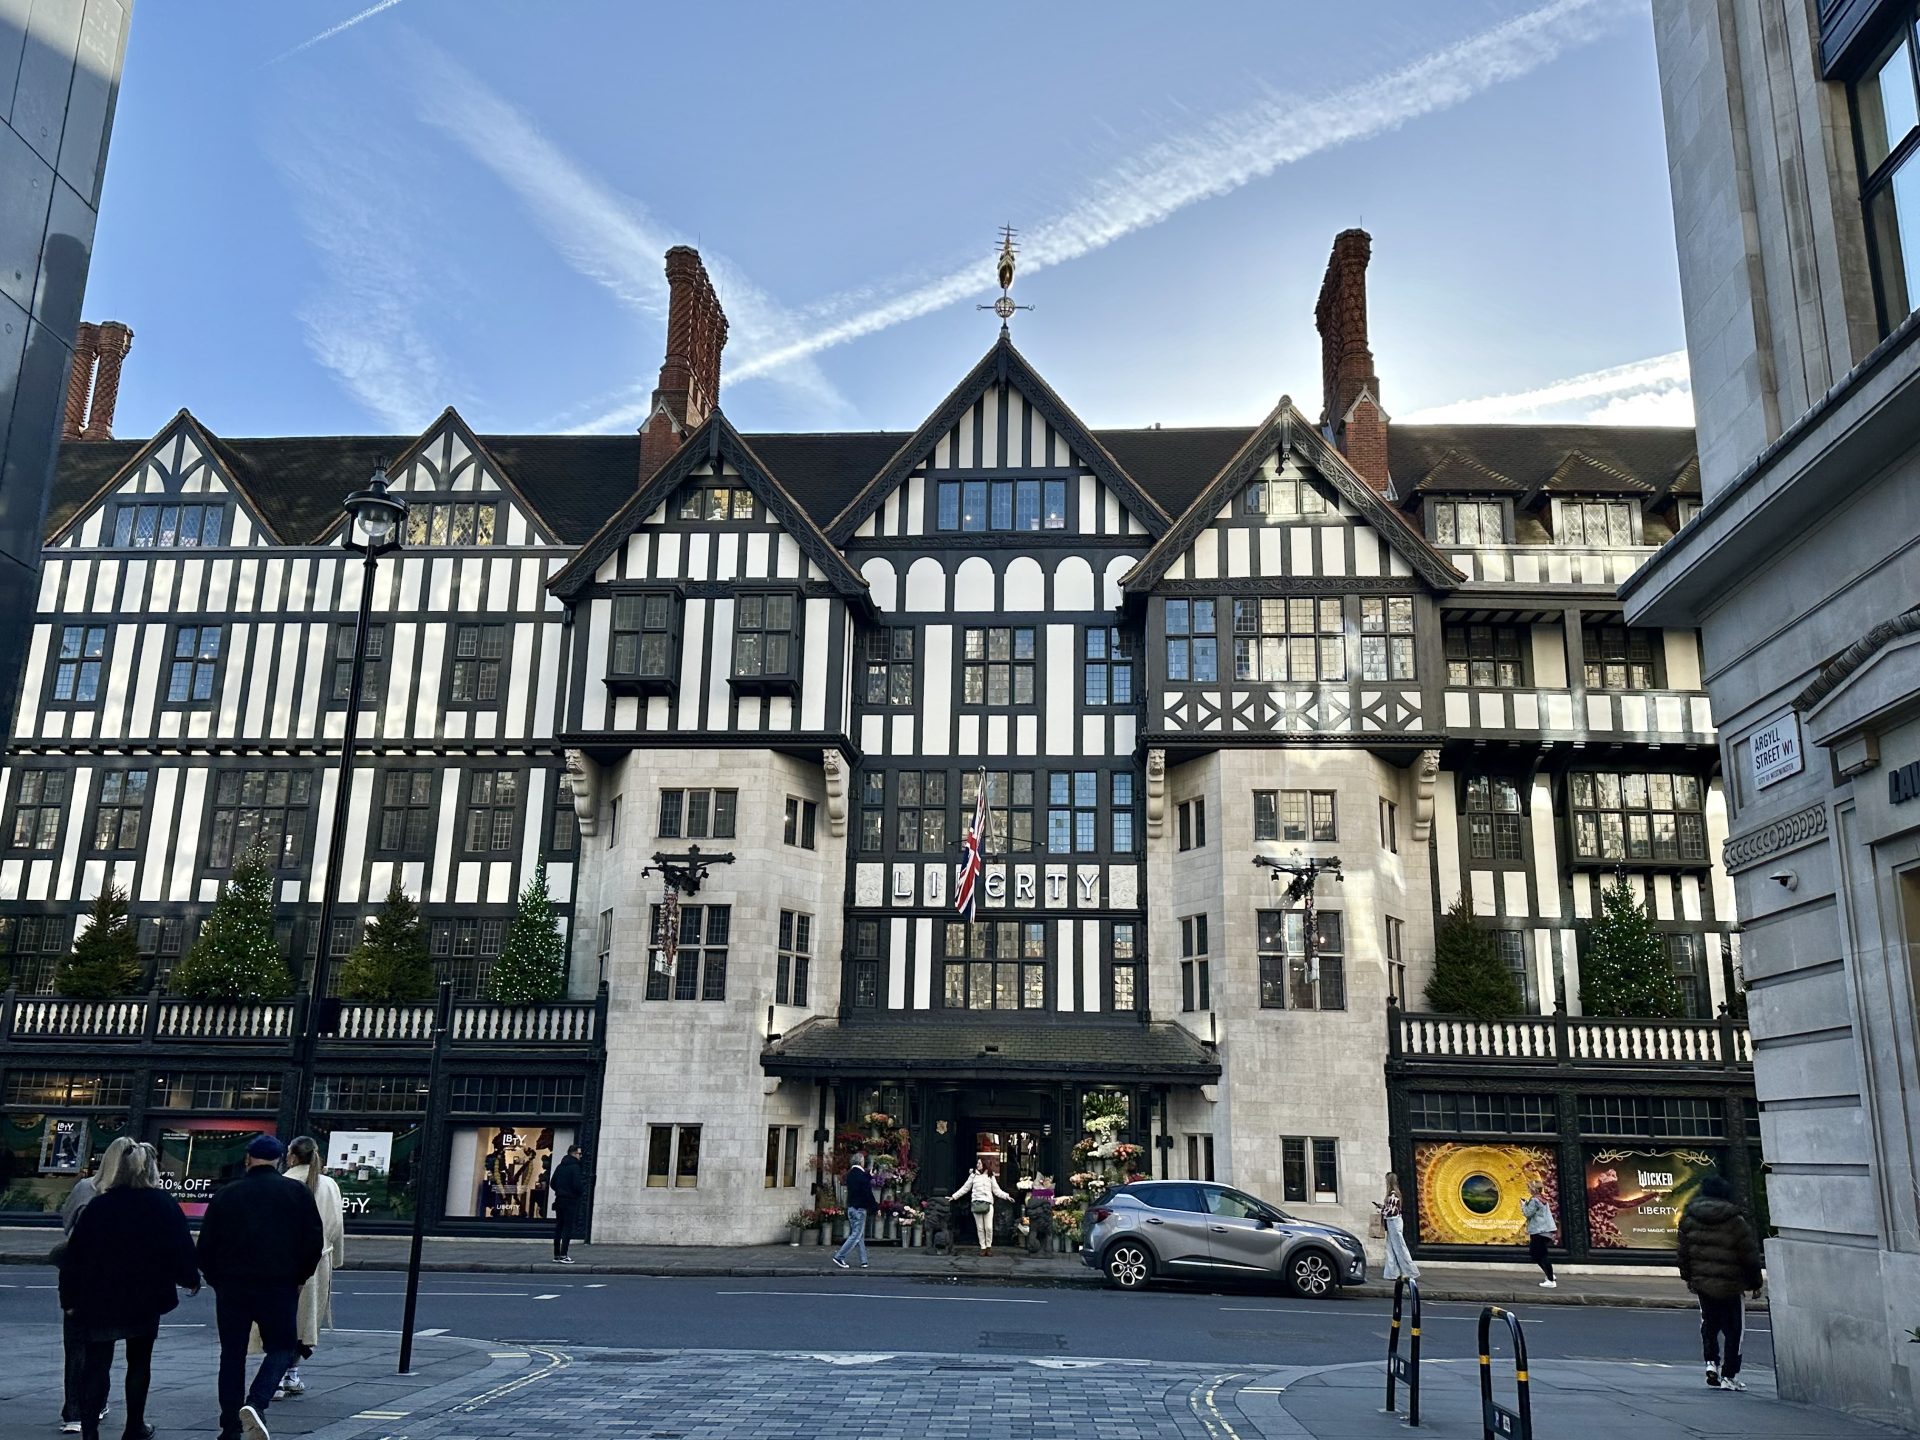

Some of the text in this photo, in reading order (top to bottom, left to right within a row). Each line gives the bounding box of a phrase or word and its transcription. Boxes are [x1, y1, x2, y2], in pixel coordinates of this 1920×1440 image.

[1754, 727, 1781, 753] ARGYLL
[1755, 738, 1794, 770] STREET W1
[893, 871, 1100, 900] LIERTY
[184, 1178, 212, 1191] OFF
[1637, 1169, 1674, 1188] WICKED
[342, 1197, 371, 1214] BTY.
[1637, 1206, 1679, 1215] LIBERTY
